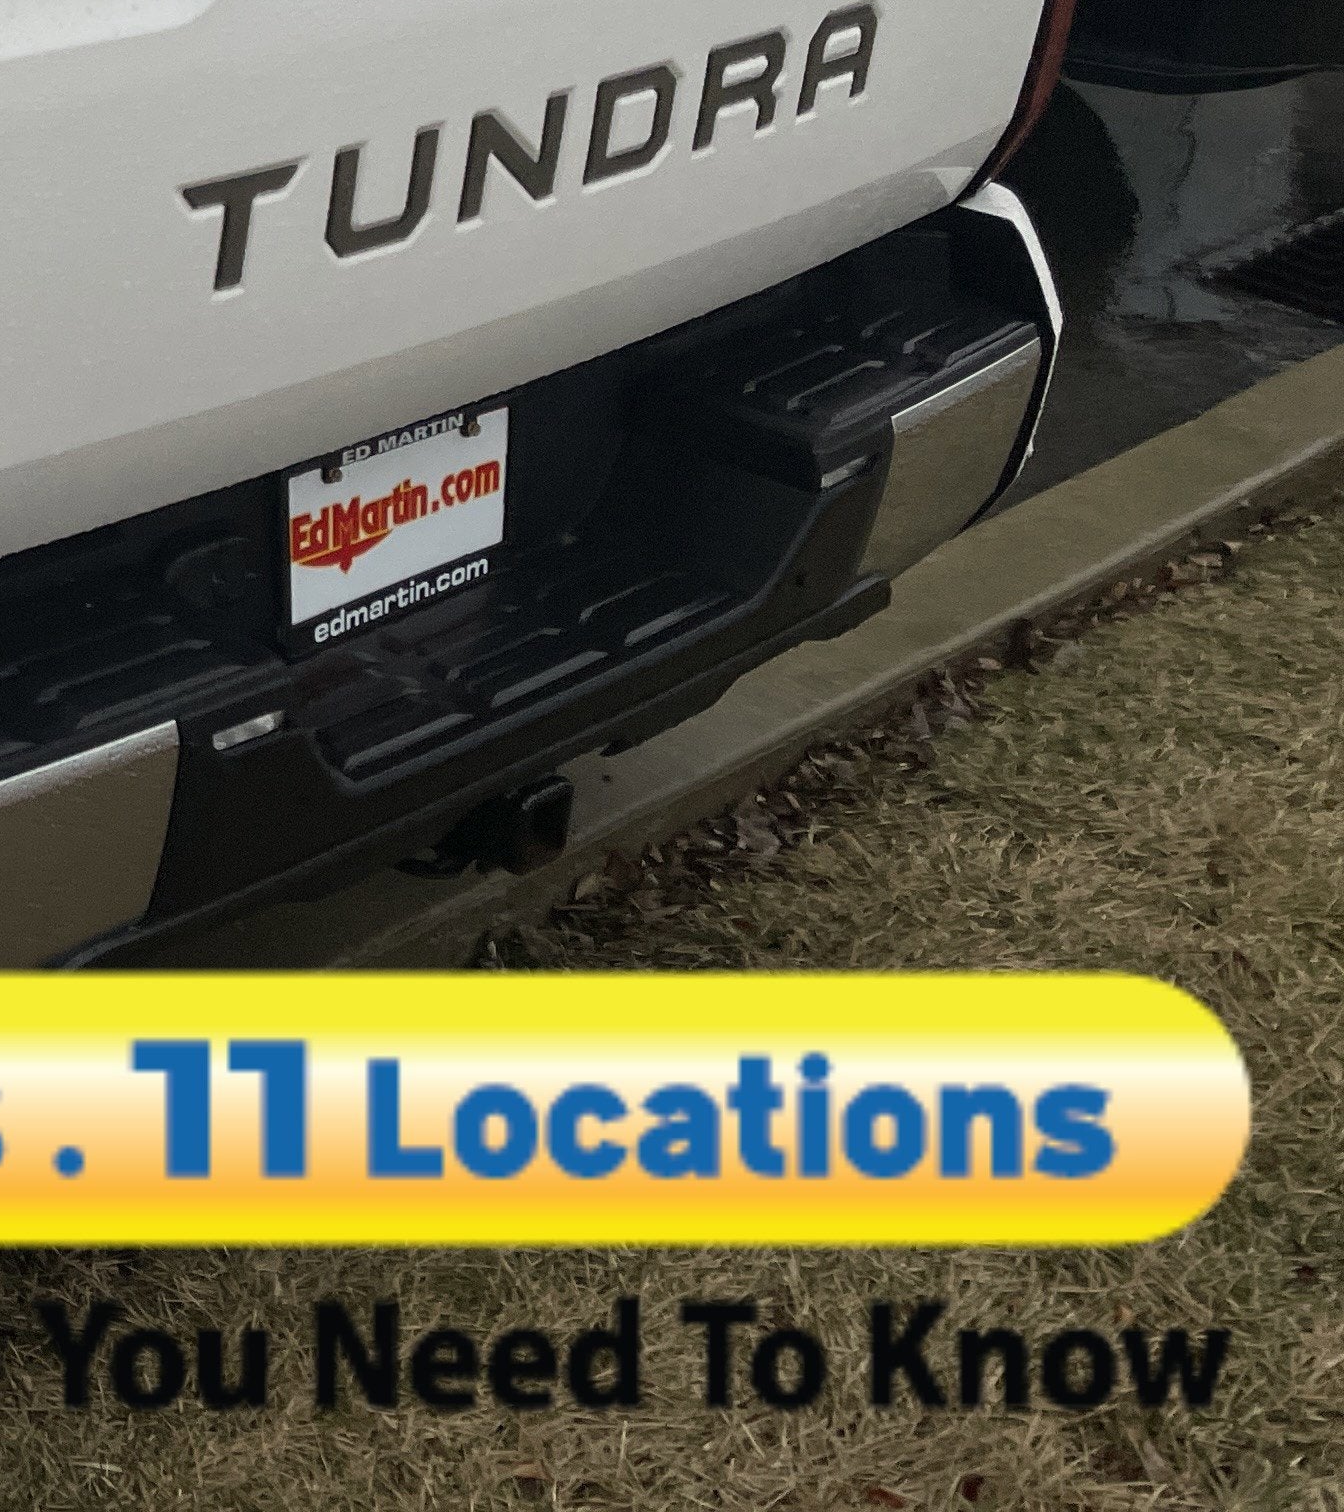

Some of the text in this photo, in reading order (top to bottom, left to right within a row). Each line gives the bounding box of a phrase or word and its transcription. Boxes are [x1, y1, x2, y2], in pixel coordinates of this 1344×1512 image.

[341, 413, 464, 467] ED MARTIN
[290, 459, 501, 564] EdMartin.com
[313, 557, 490, 644] edmartin.com
